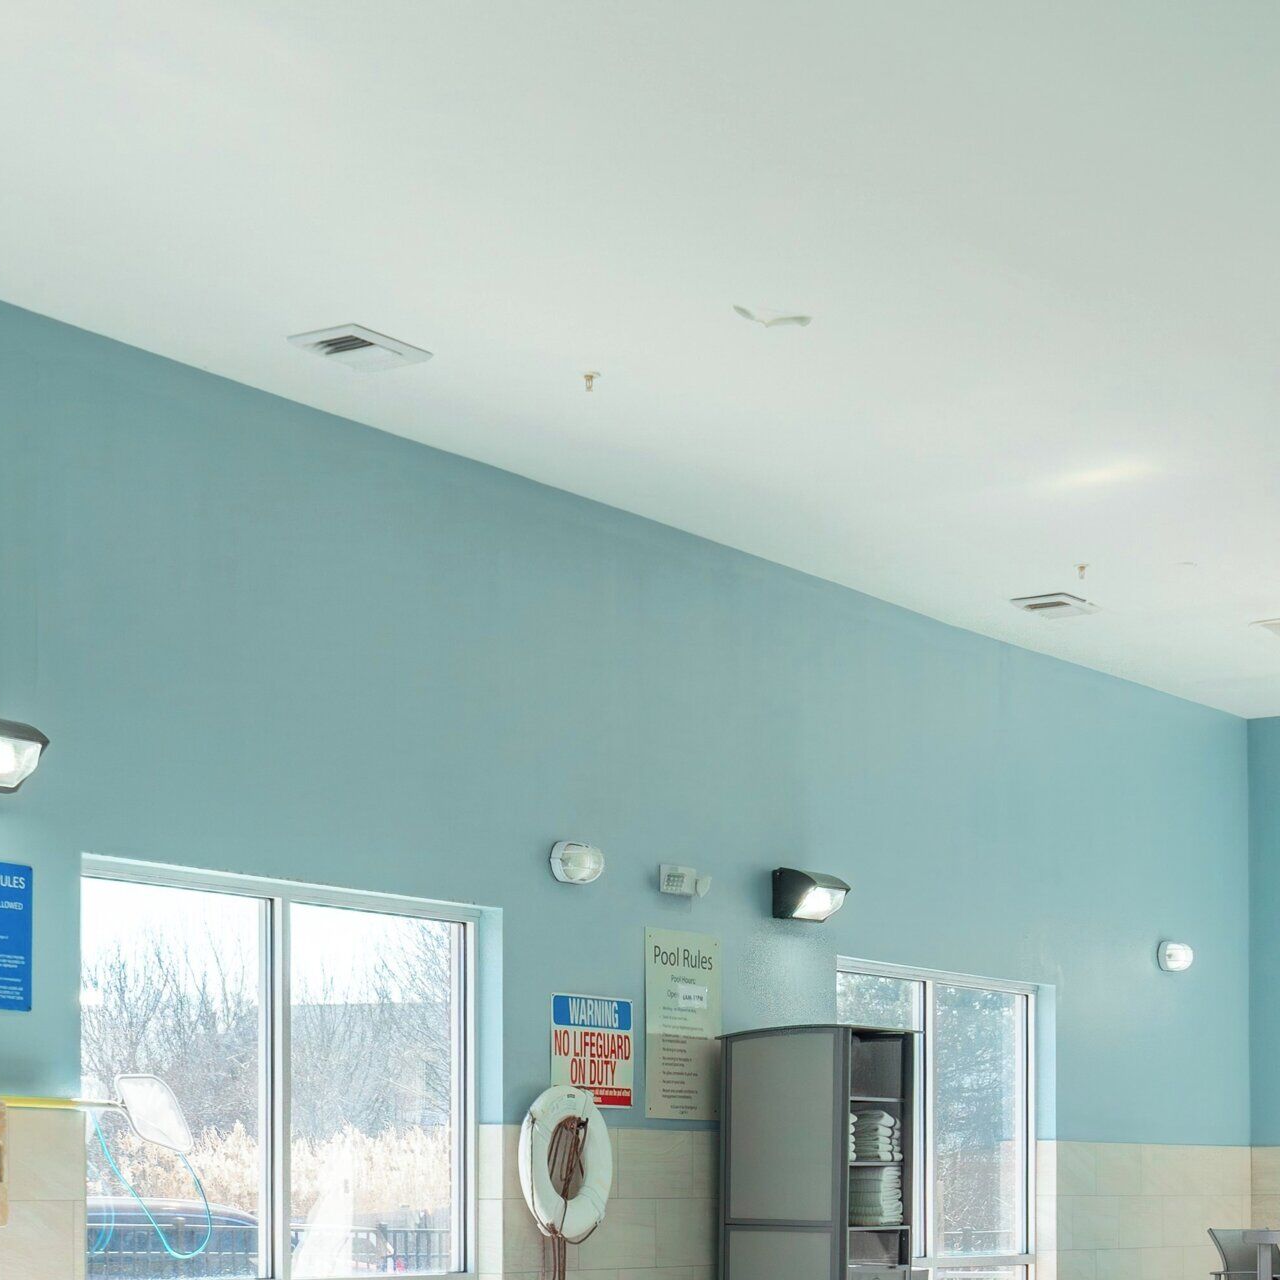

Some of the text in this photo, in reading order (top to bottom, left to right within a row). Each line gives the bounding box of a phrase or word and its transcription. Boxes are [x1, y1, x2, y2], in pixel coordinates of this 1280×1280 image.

[653, 945, 713, 971] Pool Rules
[568, 997, 619, 1029] WARNING
[554, 1029, 631, 1061] NO LIFEGUARD
[570, 1058, 617, 1087] ON DUTY
